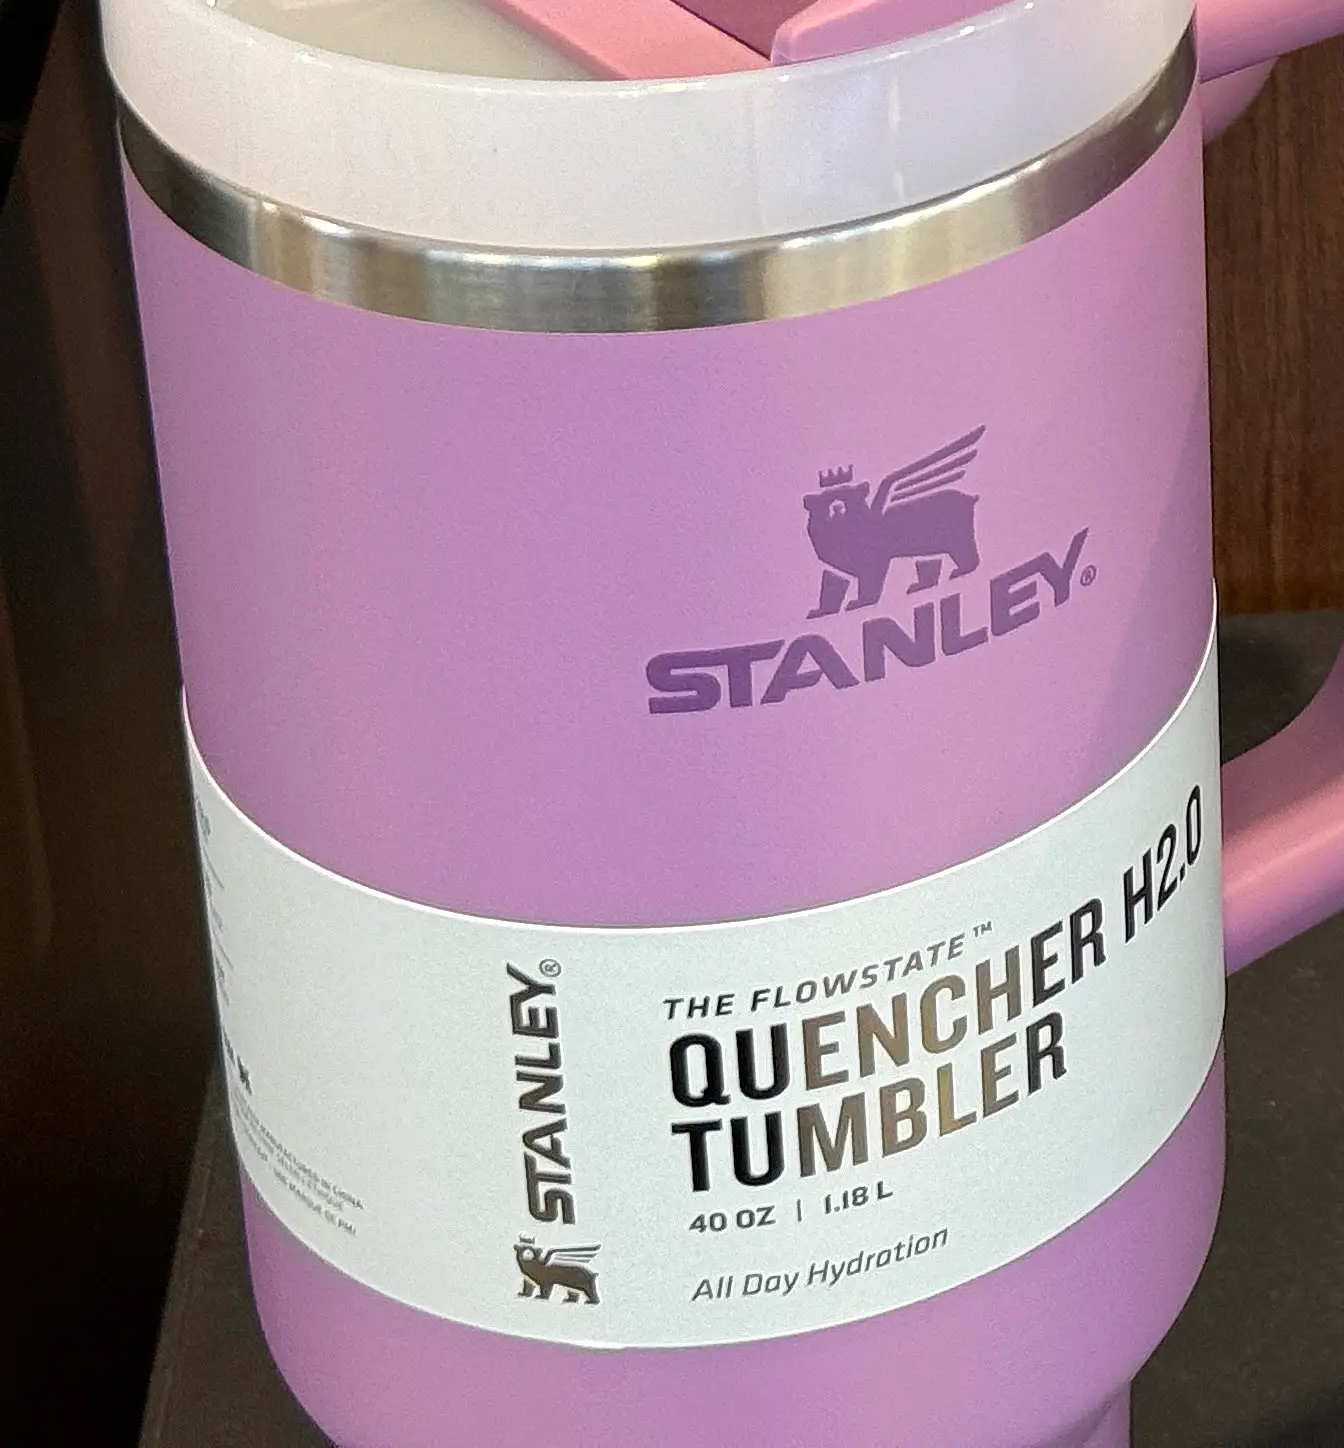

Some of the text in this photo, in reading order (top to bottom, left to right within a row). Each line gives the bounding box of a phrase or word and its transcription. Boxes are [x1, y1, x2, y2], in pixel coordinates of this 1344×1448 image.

[670, 785, 1201, 1107] QUENCHER H2.0
[663, 993, 735, 1020] THE
[671, 1011, 1067, 1192] TUMBLER
[689, 1213, 727, 1233] 40
[736, 1205, 776, 1229] OZ
[824, 1186, 869, 1214] 1.18
[877, 1181, 894, 1200] L
[691, 1227, 948, 1302] All Day Hydration
